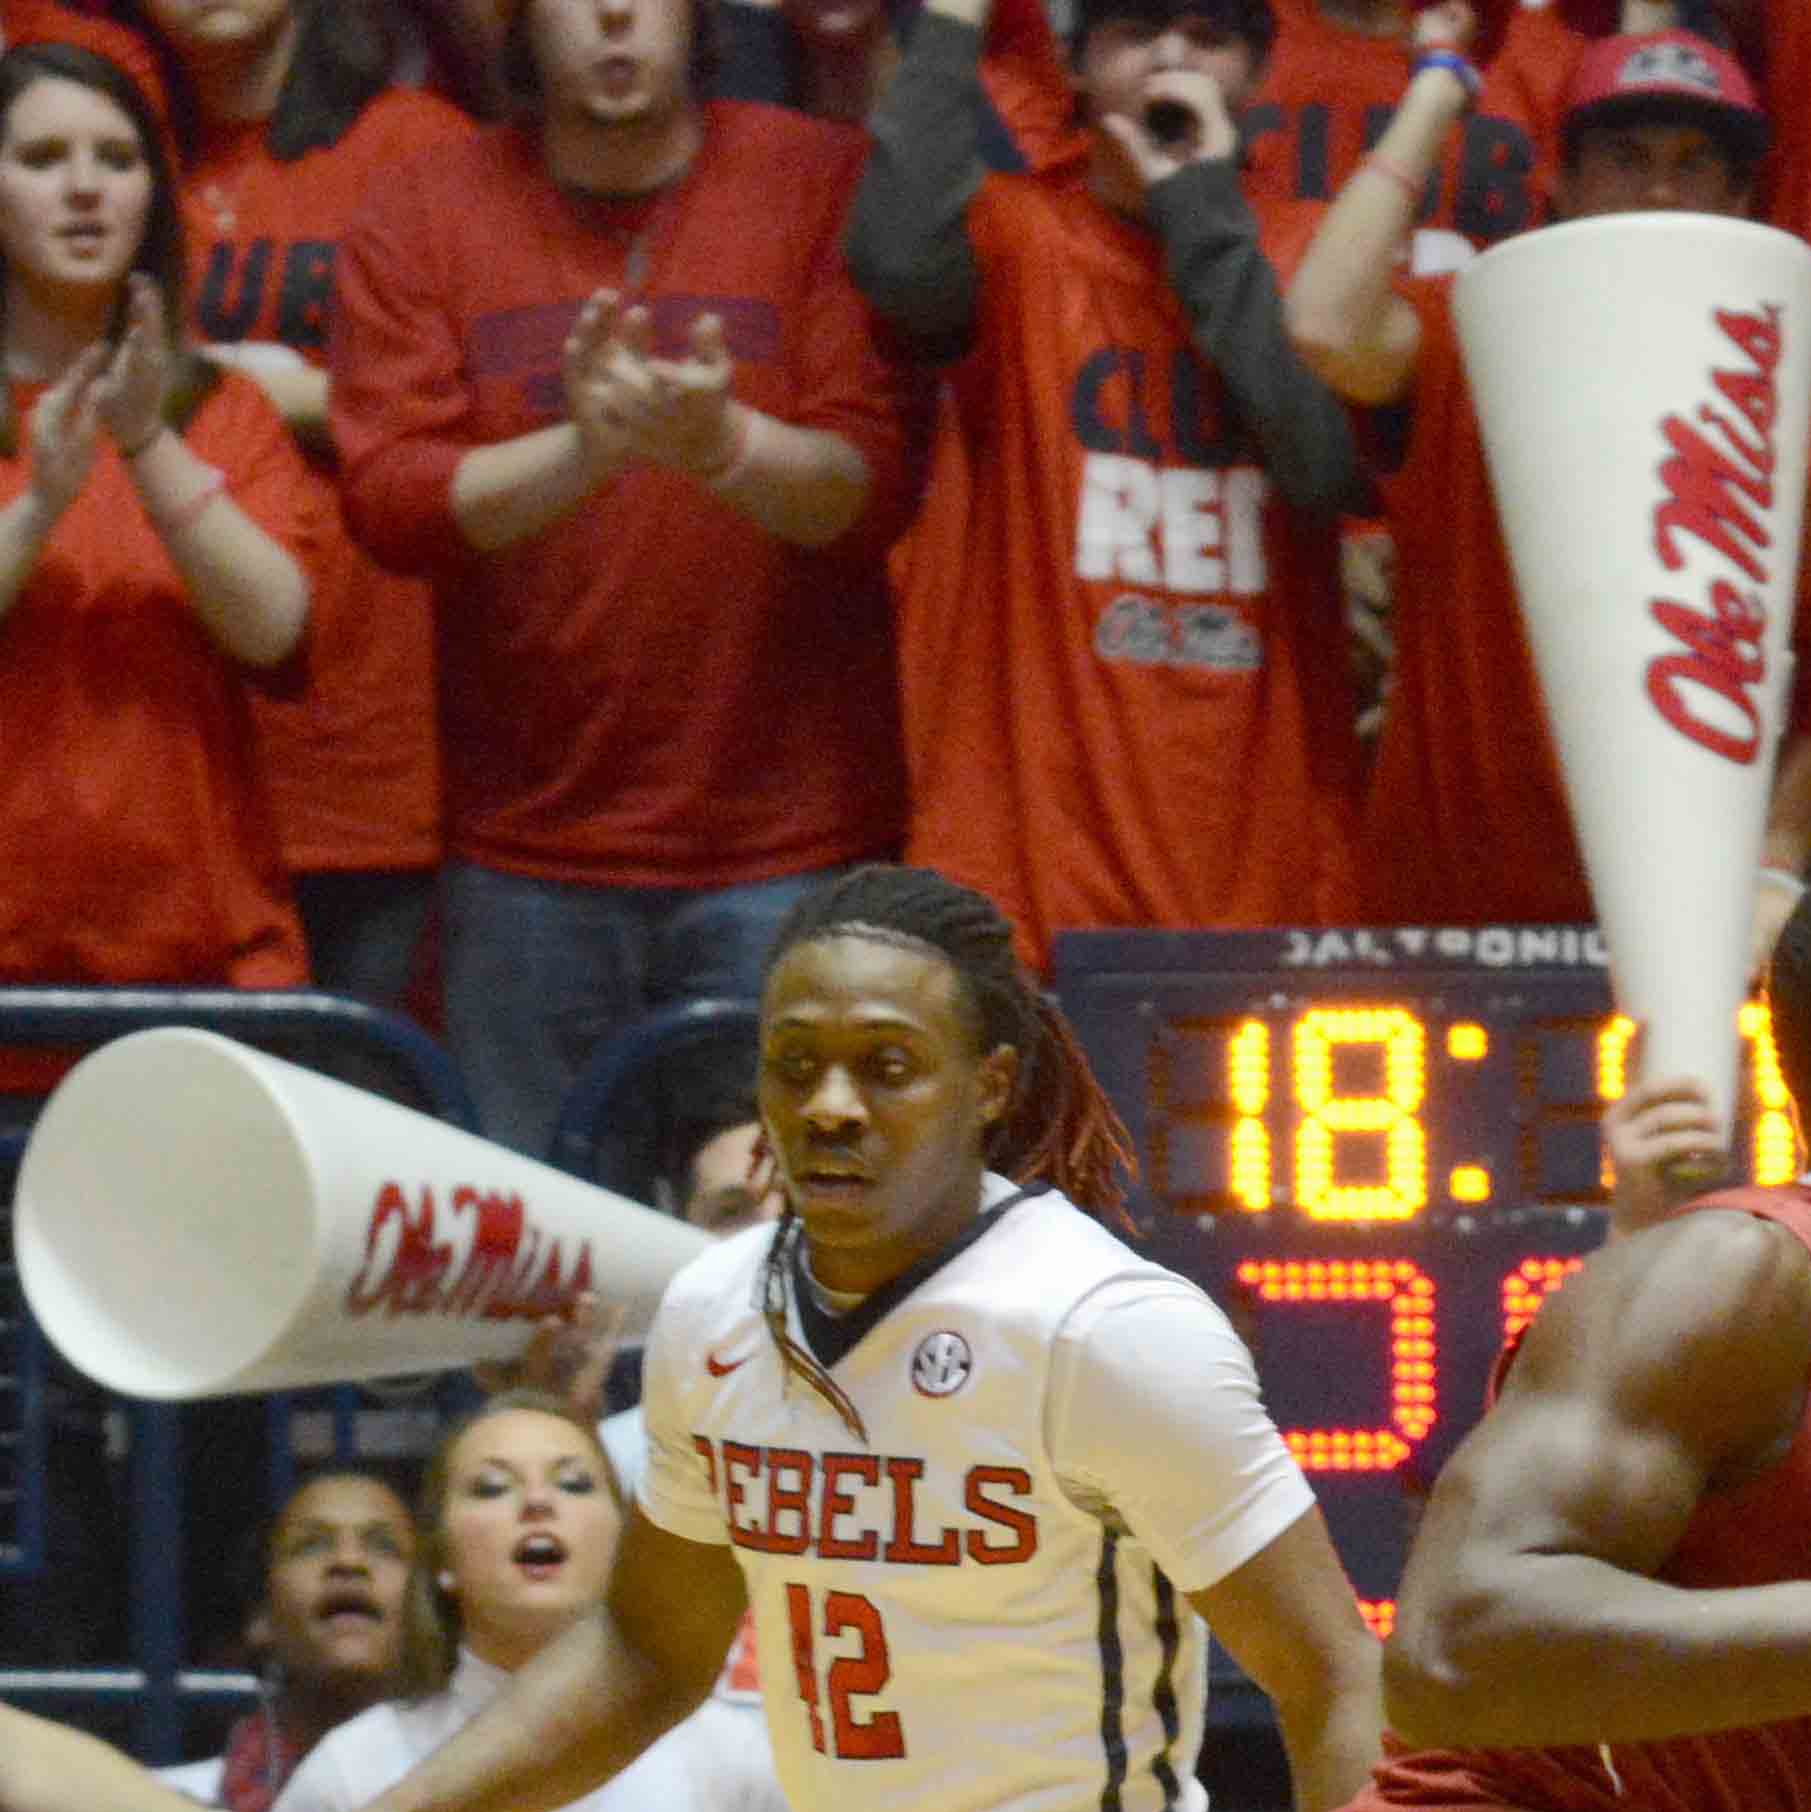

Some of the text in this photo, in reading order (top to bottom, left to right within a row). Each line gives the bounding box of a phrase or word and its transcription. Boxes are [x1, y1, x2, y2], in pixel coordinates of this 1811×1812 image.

[1643, 299, 1783, 766] Ole Miss
[784, 1581, 908, 1760] 12
